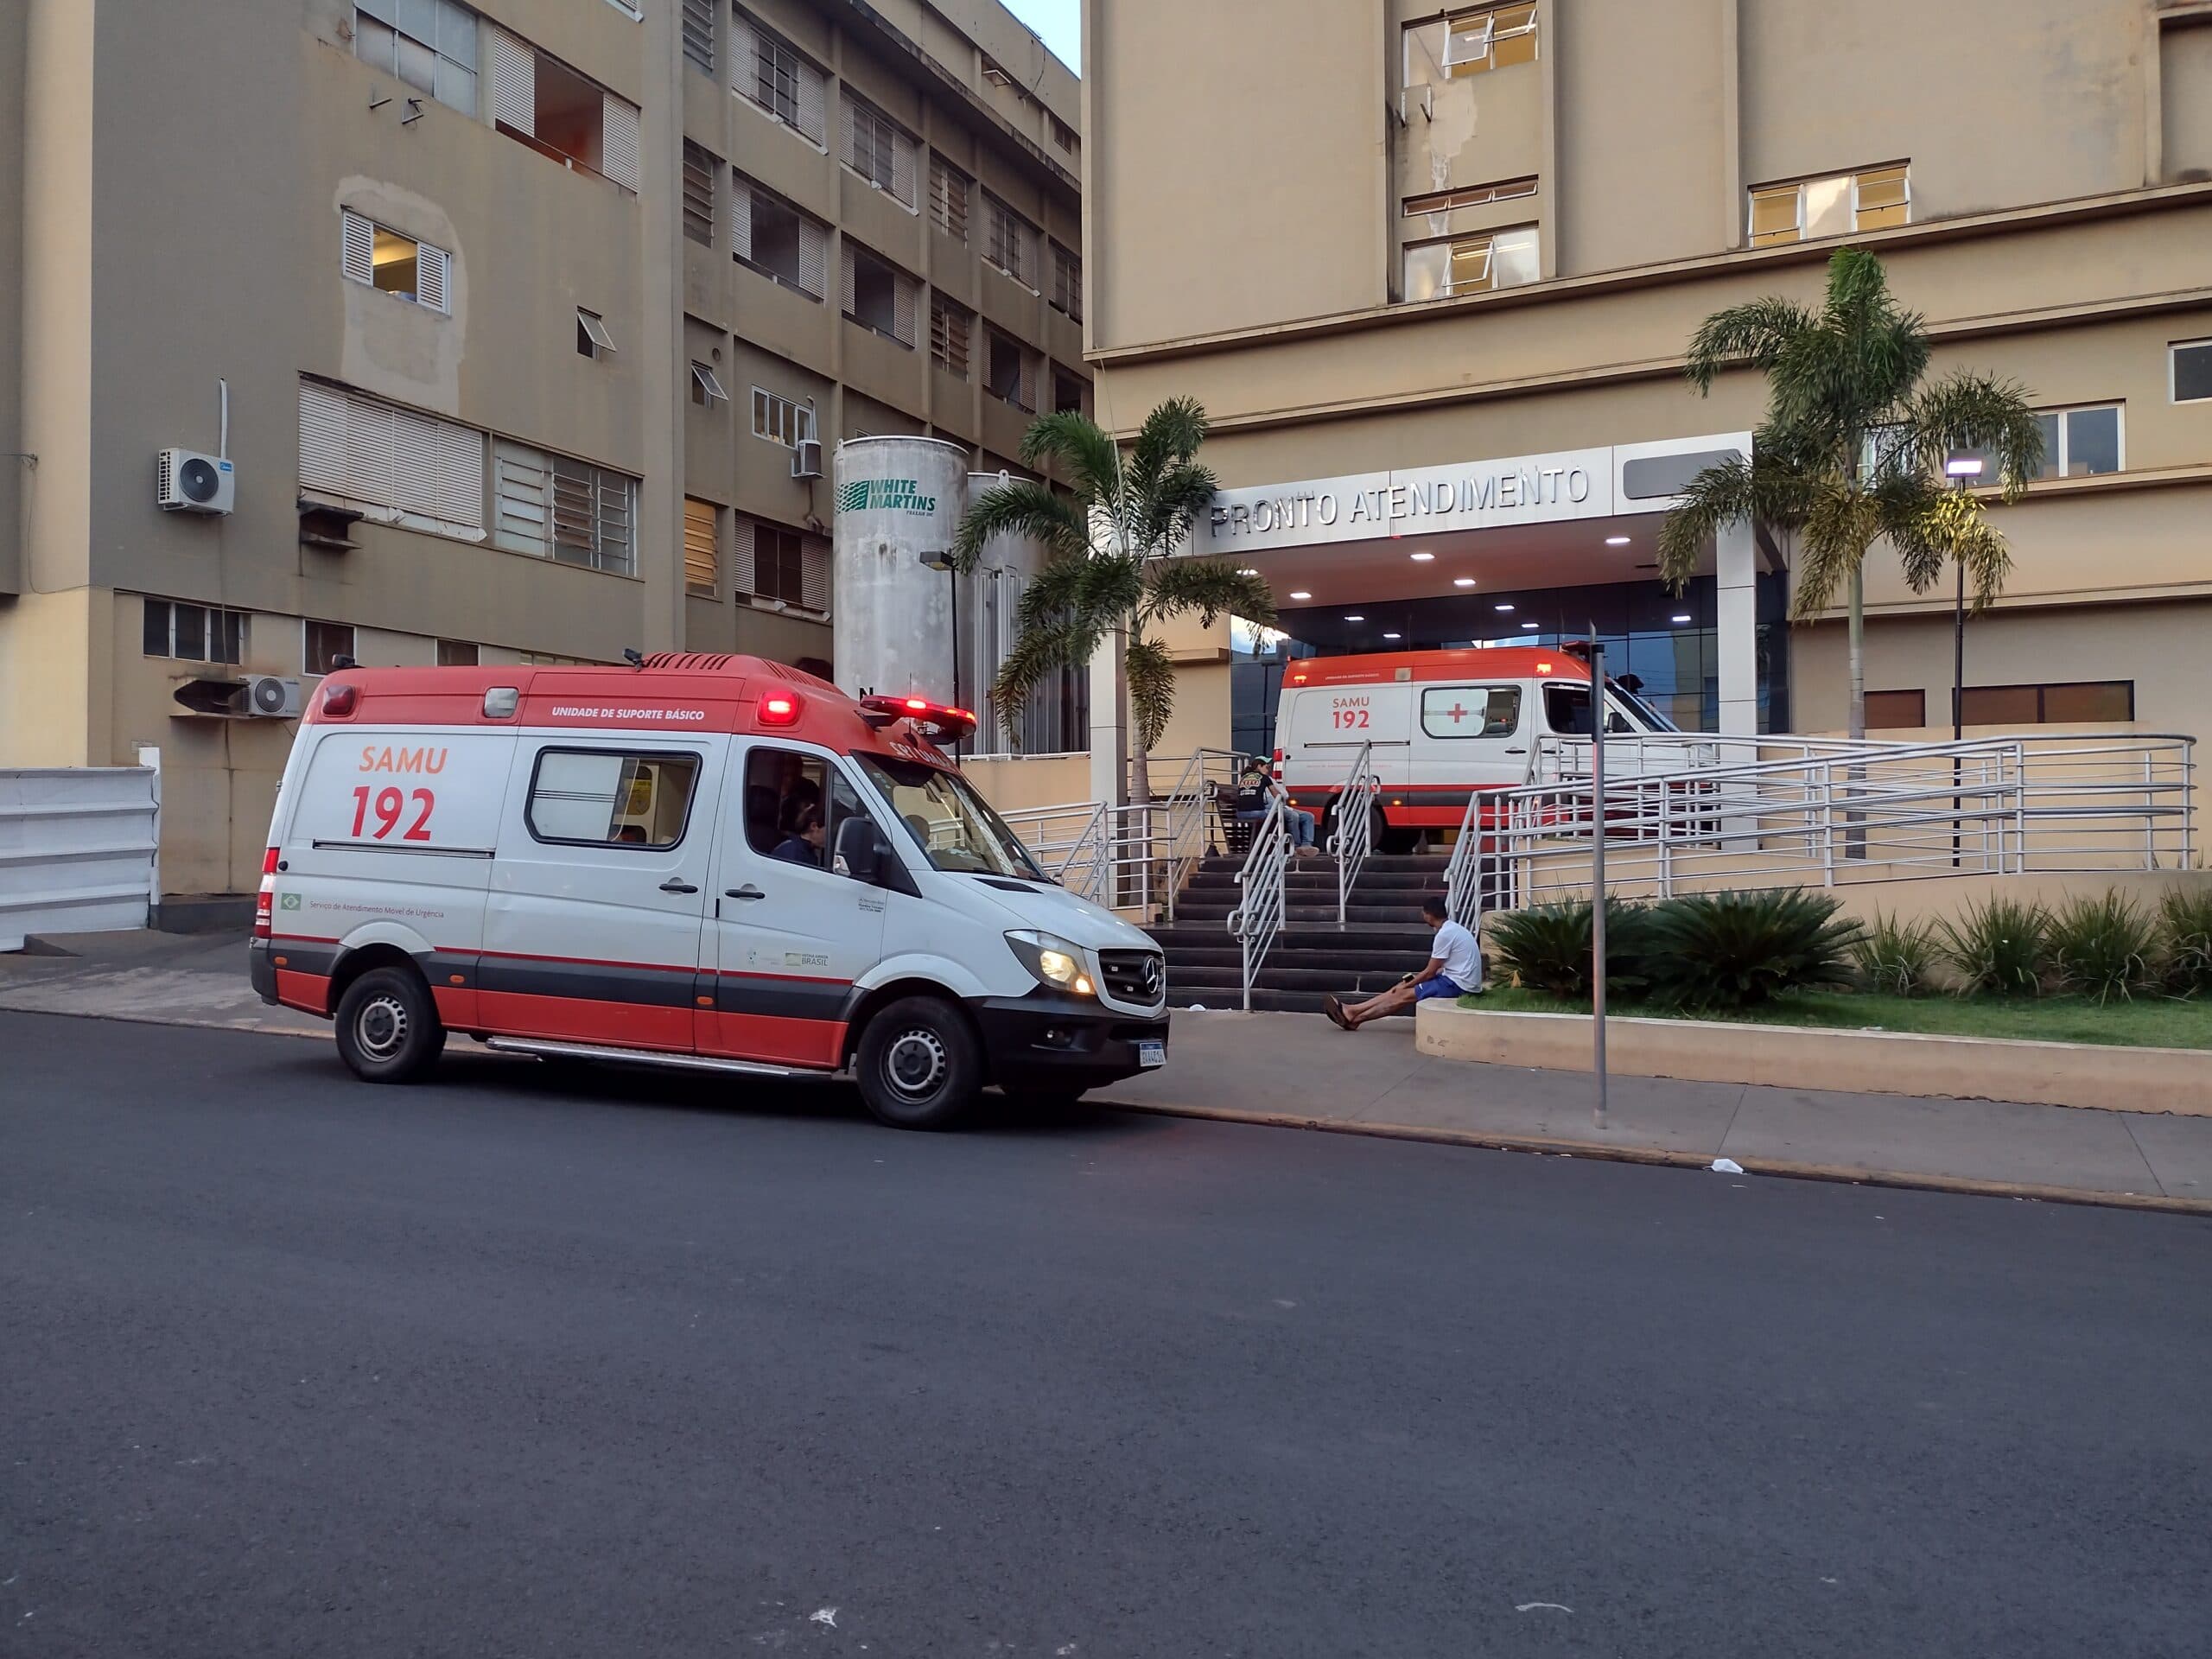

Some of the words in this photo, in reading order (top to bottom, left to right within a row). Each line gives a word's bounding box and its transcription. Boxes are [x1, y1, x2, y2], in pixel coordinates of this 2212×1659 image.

[870, 480, 917, 493] WHITE
[869, 494, 935, 511] MARTINS
[1211, 493, 1338, 537] PRONTO
[1349, 467, 1588, 522] ATENDIMENTO
[1332, 697, 1370, 708] SAMU
[551, 707, 599, 717] UNIDADE
[601, 709, 615, 718] DE
[616, 709, 663, 719] SUPORTE
[664, 709, 705, 720] BÁSICO
[1332, 710, 1370, 728] 192
[359, 746, 448, 774] SAMU
[352, 785, 435, 842] 192
[802, 957, 828, 966] BRASIL
